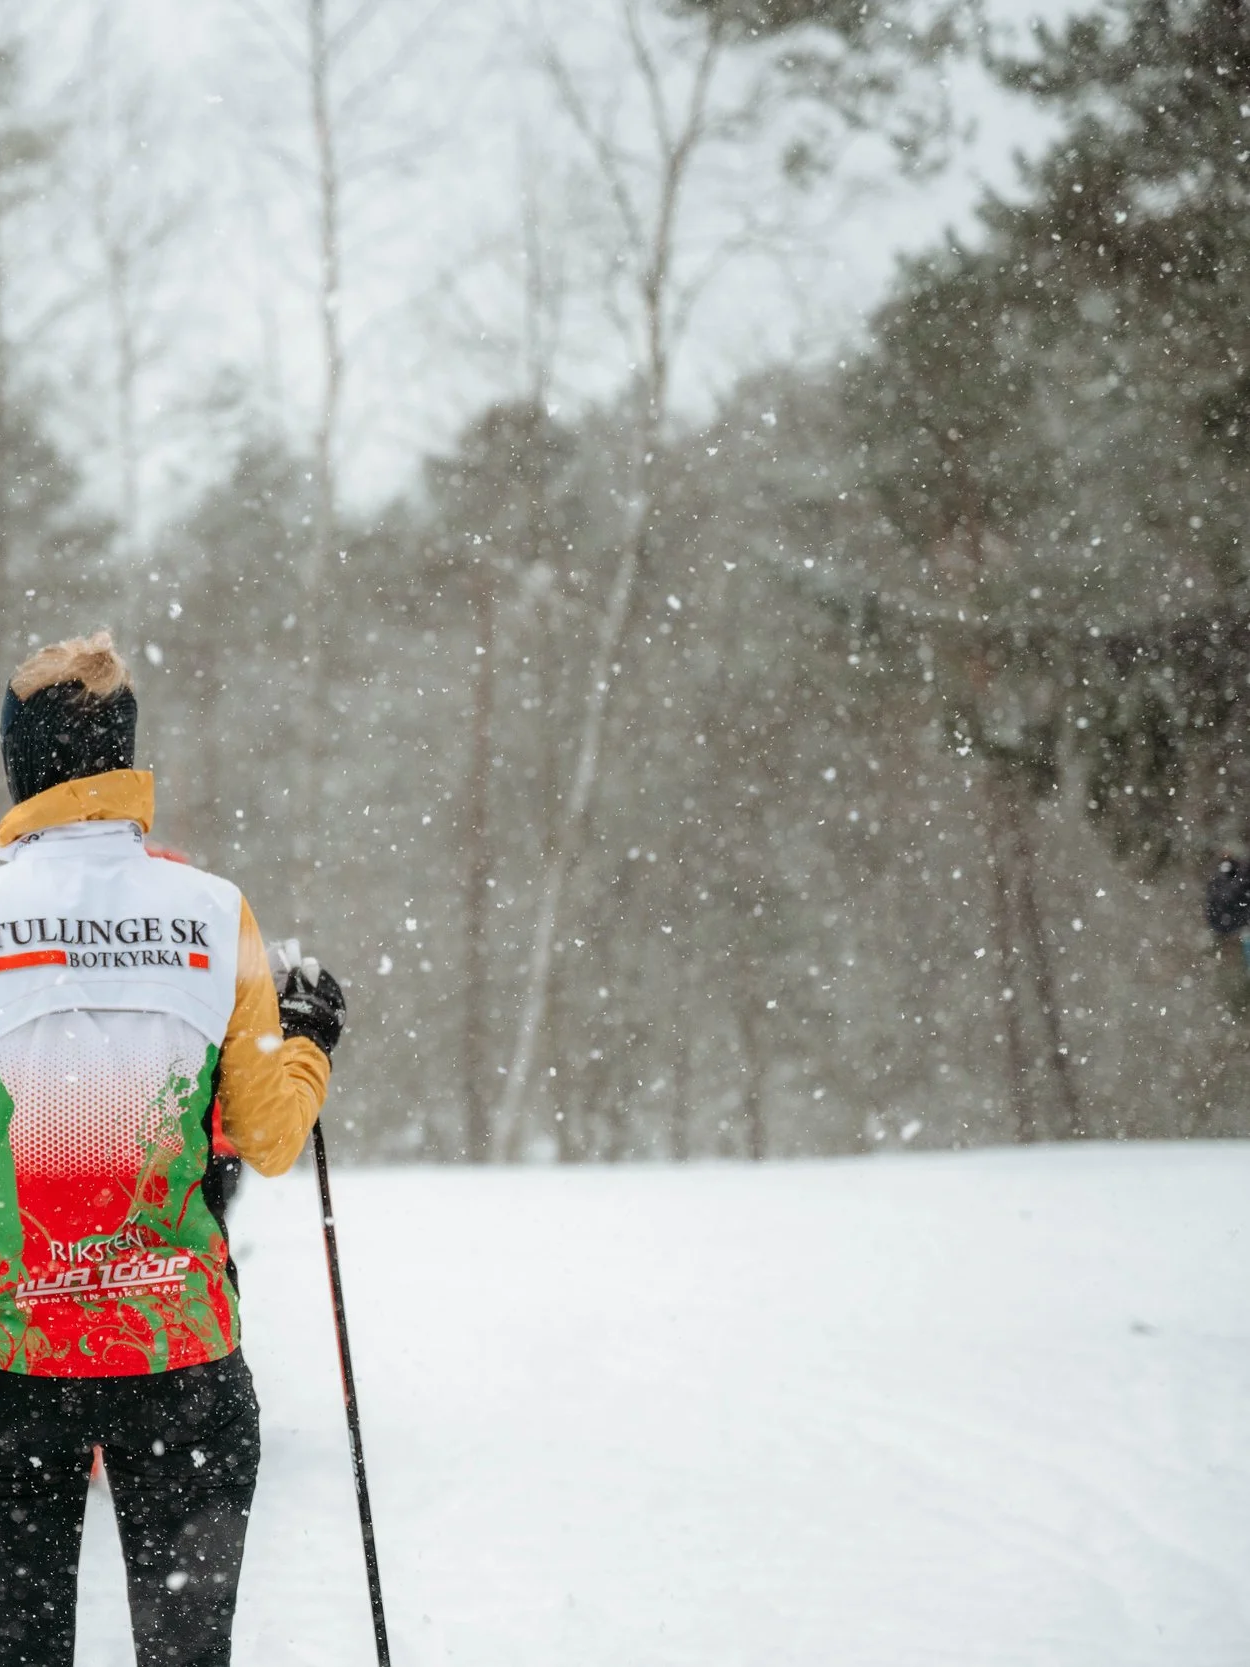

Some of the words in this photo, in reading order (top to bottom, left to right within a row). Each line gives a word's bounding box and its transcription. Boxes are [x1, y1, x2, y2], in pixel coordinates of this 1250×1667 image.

[170, 918, 209, 948] SK
[69, 950, 183, 969] BOTKYRKA
[50, 1228, 144, 1264] RIKSTEN
[15, 1293, 100, 1309] MOUNTAIN
[107, 1288, 144, 1299] BIKE
[152, 1284, 187, 1293] RACE
